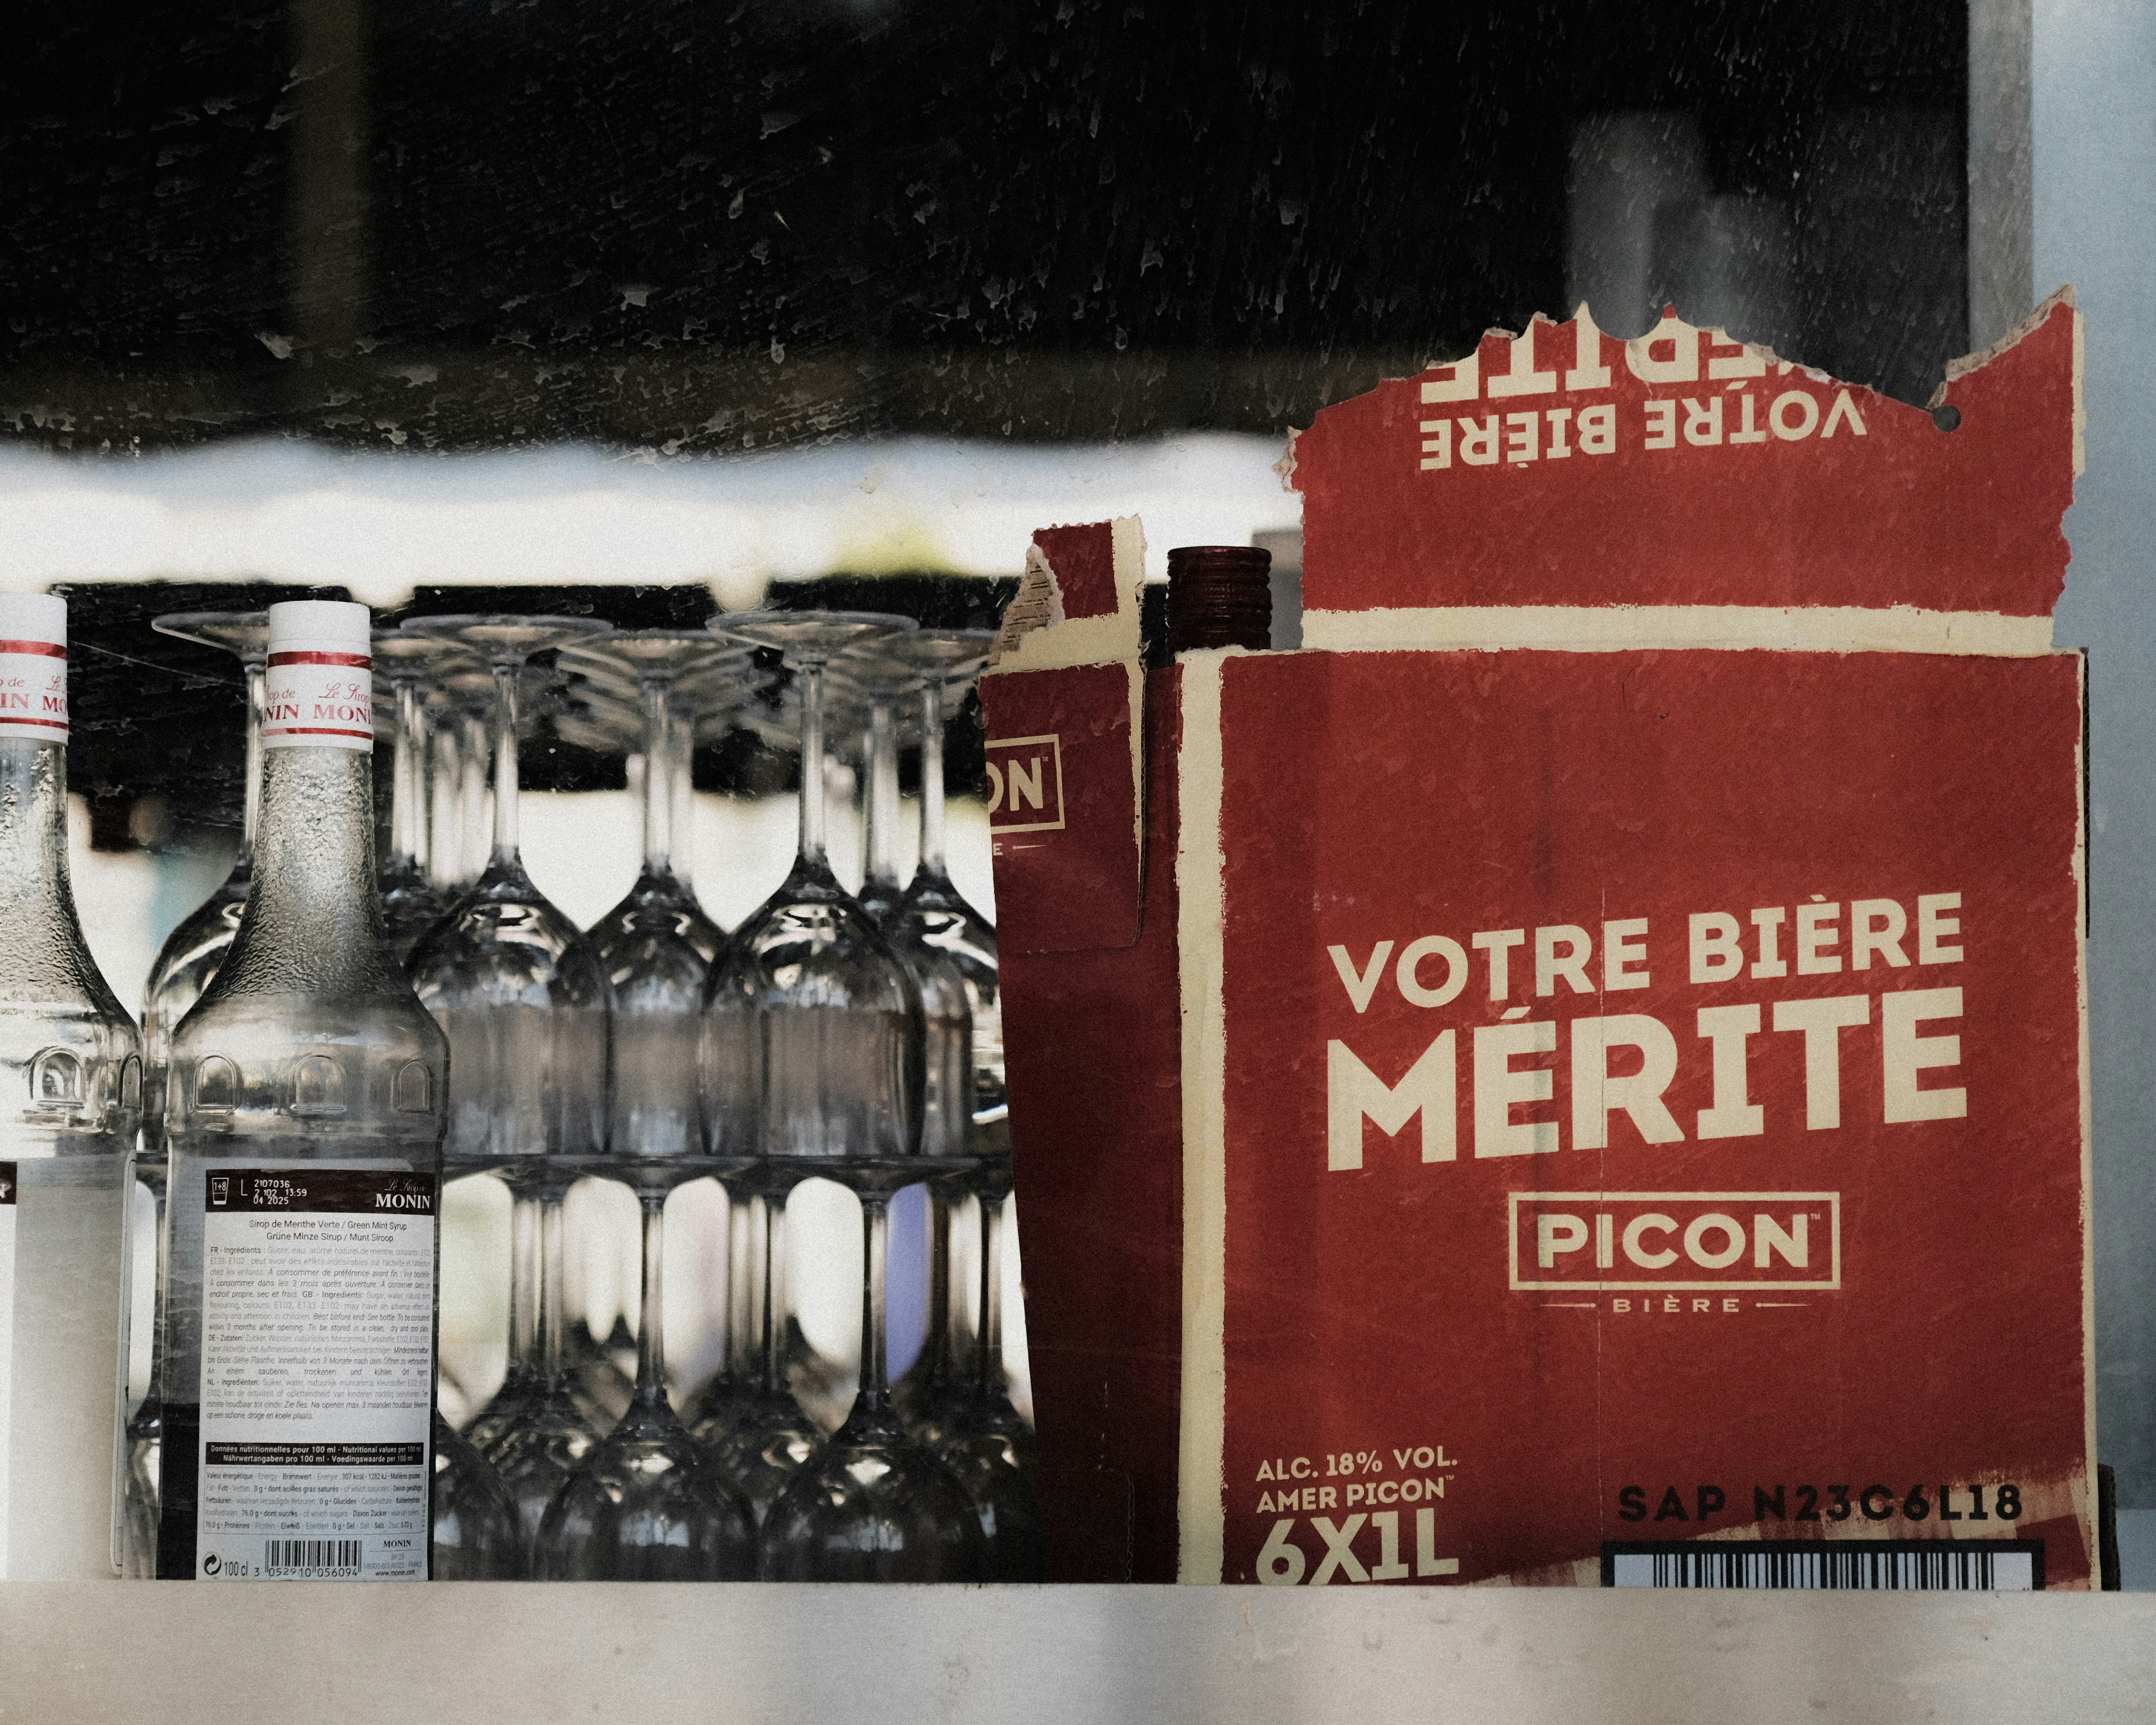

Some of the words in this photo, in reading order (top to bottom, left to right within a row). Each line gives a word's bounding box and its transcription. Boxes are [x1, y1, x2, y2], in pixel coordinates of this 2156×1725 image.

[1644, 388, 1867, 450] VOTRE
[1420, 404, 1616, 471] BIÈRE
[8, 677, 24, 687] de
[282, 689, 295, 698] de
[318, 683, 341, 699] Le
[1326, 917, 1651, 1014] VOTRE
[1688, 892, 1964, 985] BIÈRE
[1327, 986, 1968, 1172] MÉRITE
[375, 1193, 430, 1209] MONIN
[250, 1220, 270, 1229] Sirop
[389, 1222, 407, 1231] Syrup
[321, 1233, 342, 1242] Sirup
[371, 1234, 393, 1243] Siroop
[1537, 1213, 1809, 1269] PICON
[333, 1269, 369, 1278] préférence
[1613, 1295, 1740, 1313] BIÈRE
[223, 1455, 284, 1463] Nährwertangaben
[1255, 1457, 1318, 1482] ALC.
[1326, 1450, 1382, 1476] 18%
[1393, 1445, 1458, 1470] VOL.
[1256, 1486, 1337, 1514] AMER
[1347, 1477, 1445, 1506] PICON
[1618, 1484, 1727, 1523] SAP
[1754, 1483, 2023, 1522] N23C6L18
[384, 1540, 411, 1548] MONIN
[1255, 1507, 1459, 1585] 6X1L
[224, 1562, 238, 1576] 100
[241, 1561, 248, 1576] cl
[254, 1567, 260, 1576] 3
[269, 1568, 311, 1577] 052910
[317, 1568, 357, 1577] 056094
